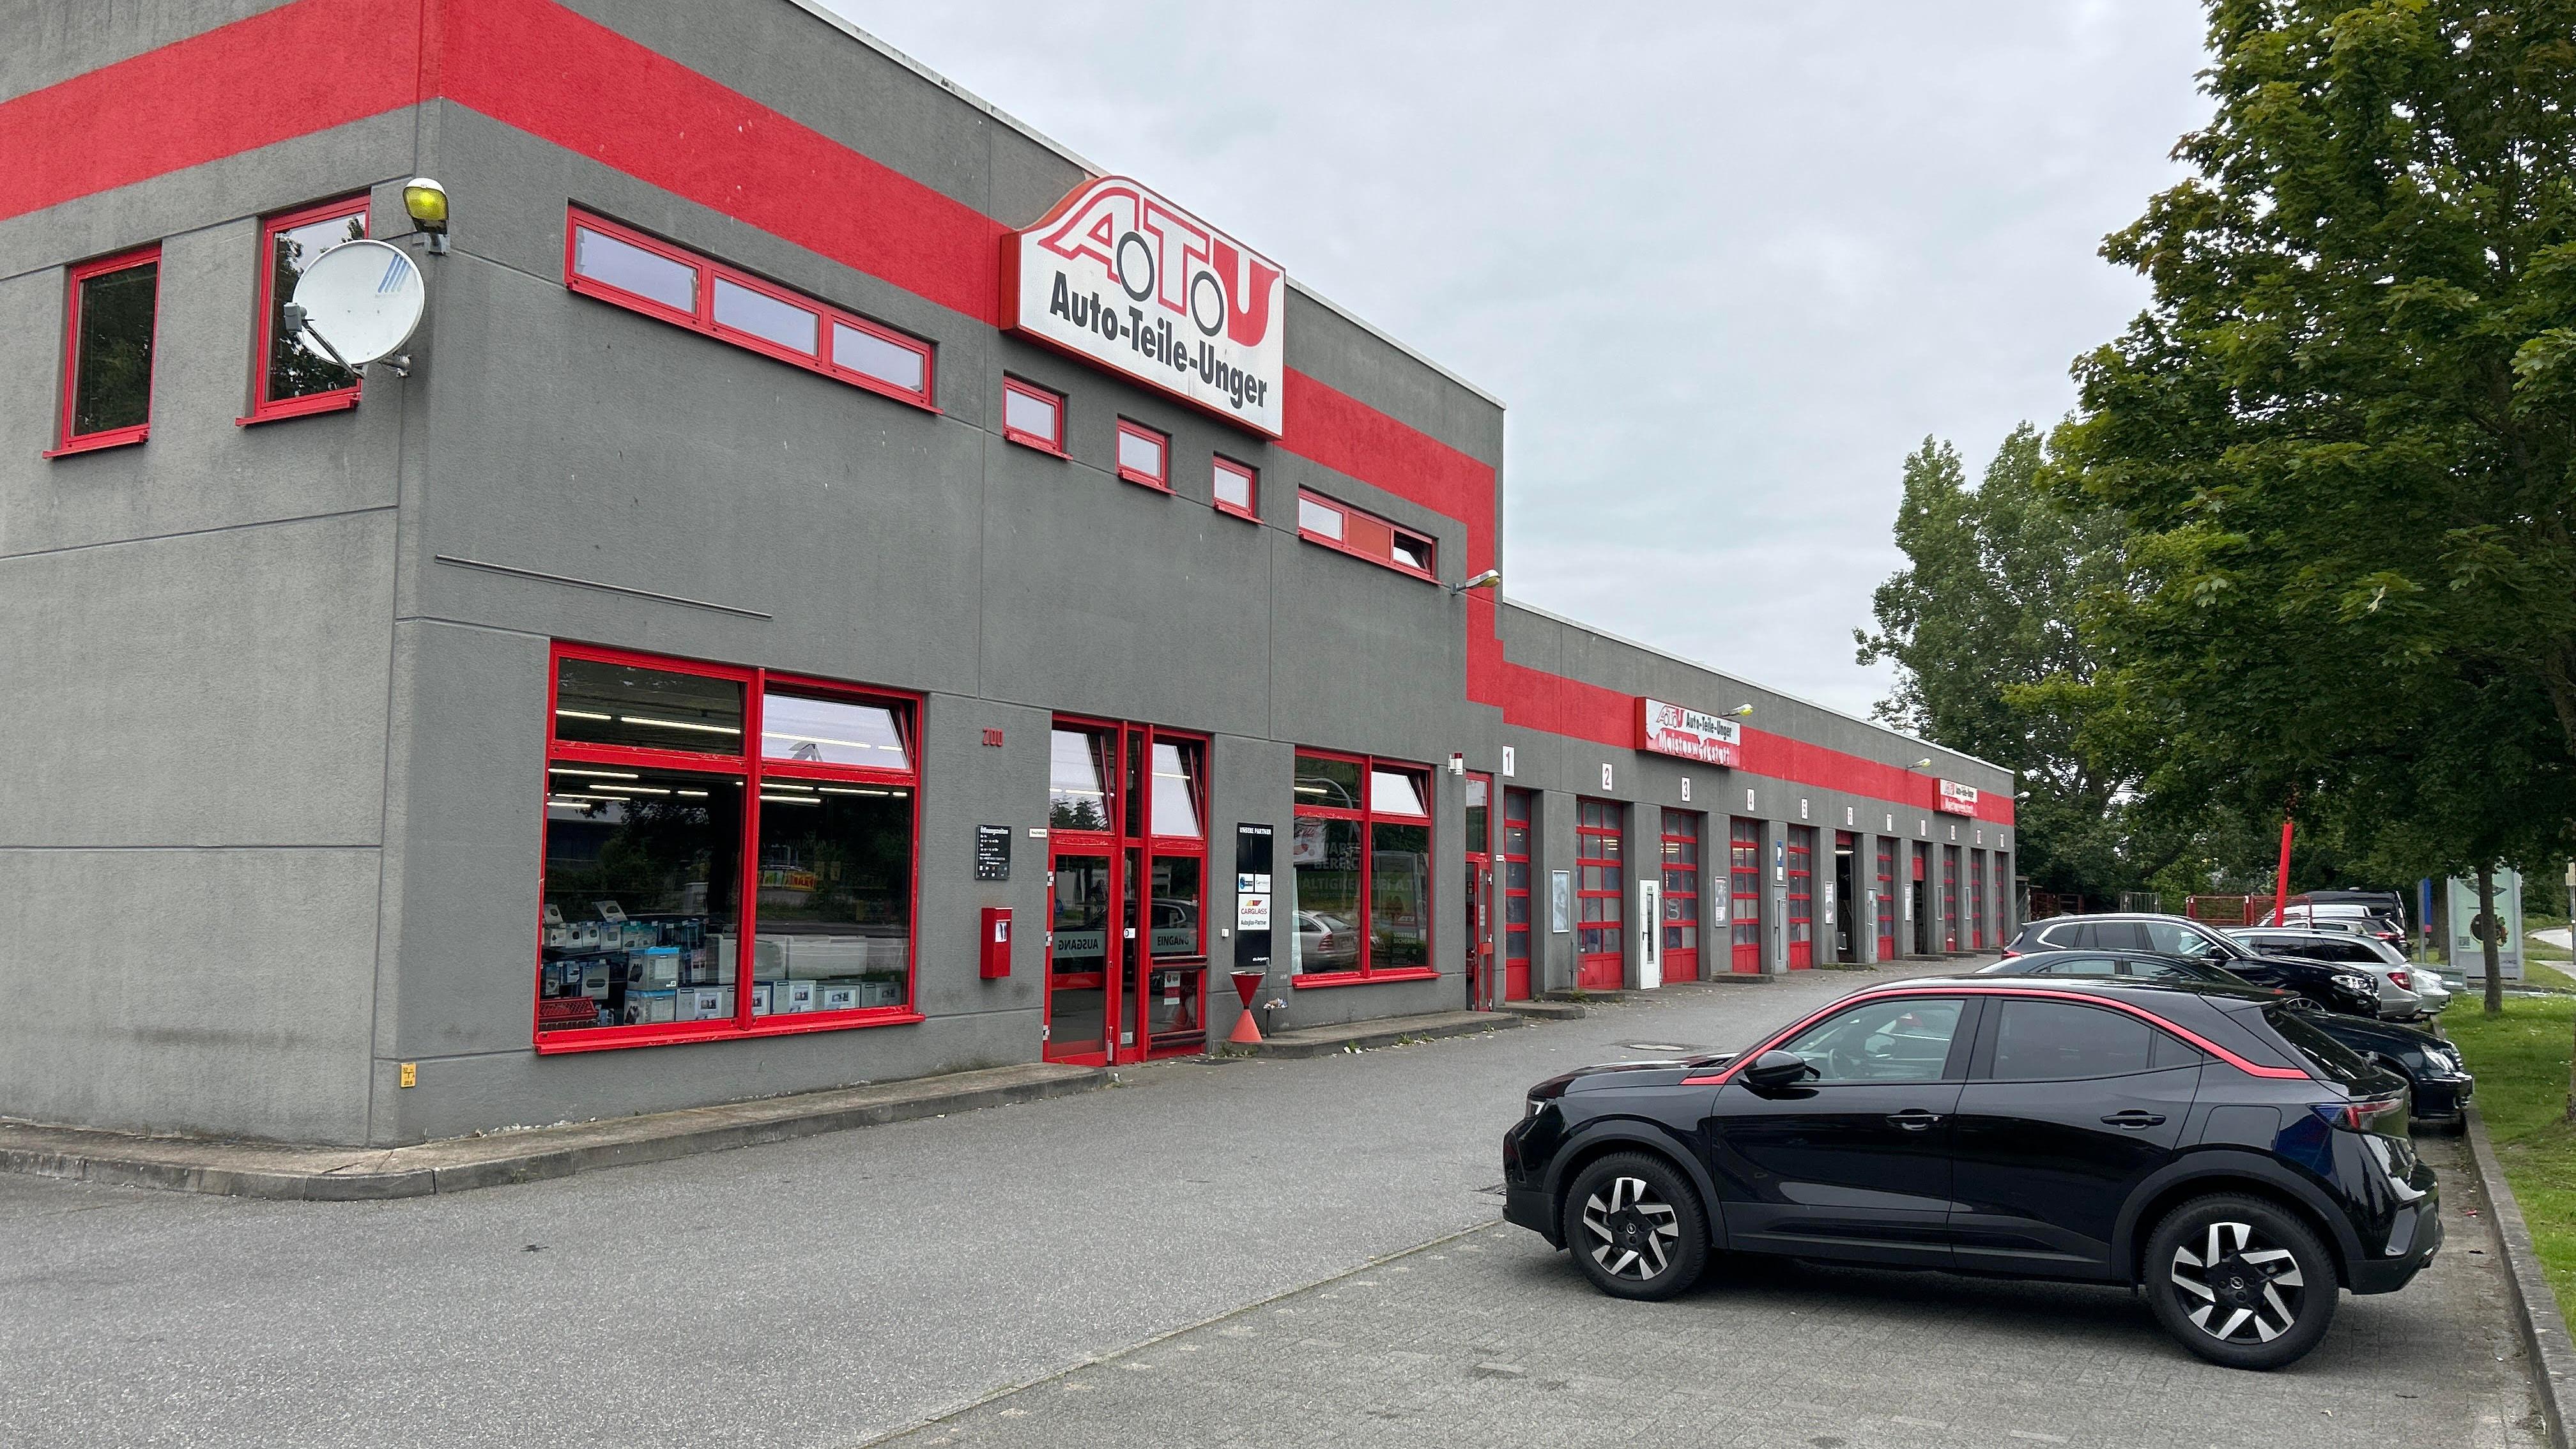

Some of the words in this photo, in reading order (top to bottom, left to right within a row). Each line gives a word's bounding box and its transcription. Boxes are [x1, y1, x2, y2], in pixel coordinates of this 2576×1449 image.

[1050, 270, 1267, 409] Auto-Teile-Unger
[1686, 712, 1732, 740] Auto-Teile-Unger
[983, 727, 1004, 746] 700
[1505, 751, 1510, 771] 1
[1604, 767, 1610, 786] 2
[1683, 781, 1688, 798] 3
[1157, 935, 1190, 946] EINGANG
